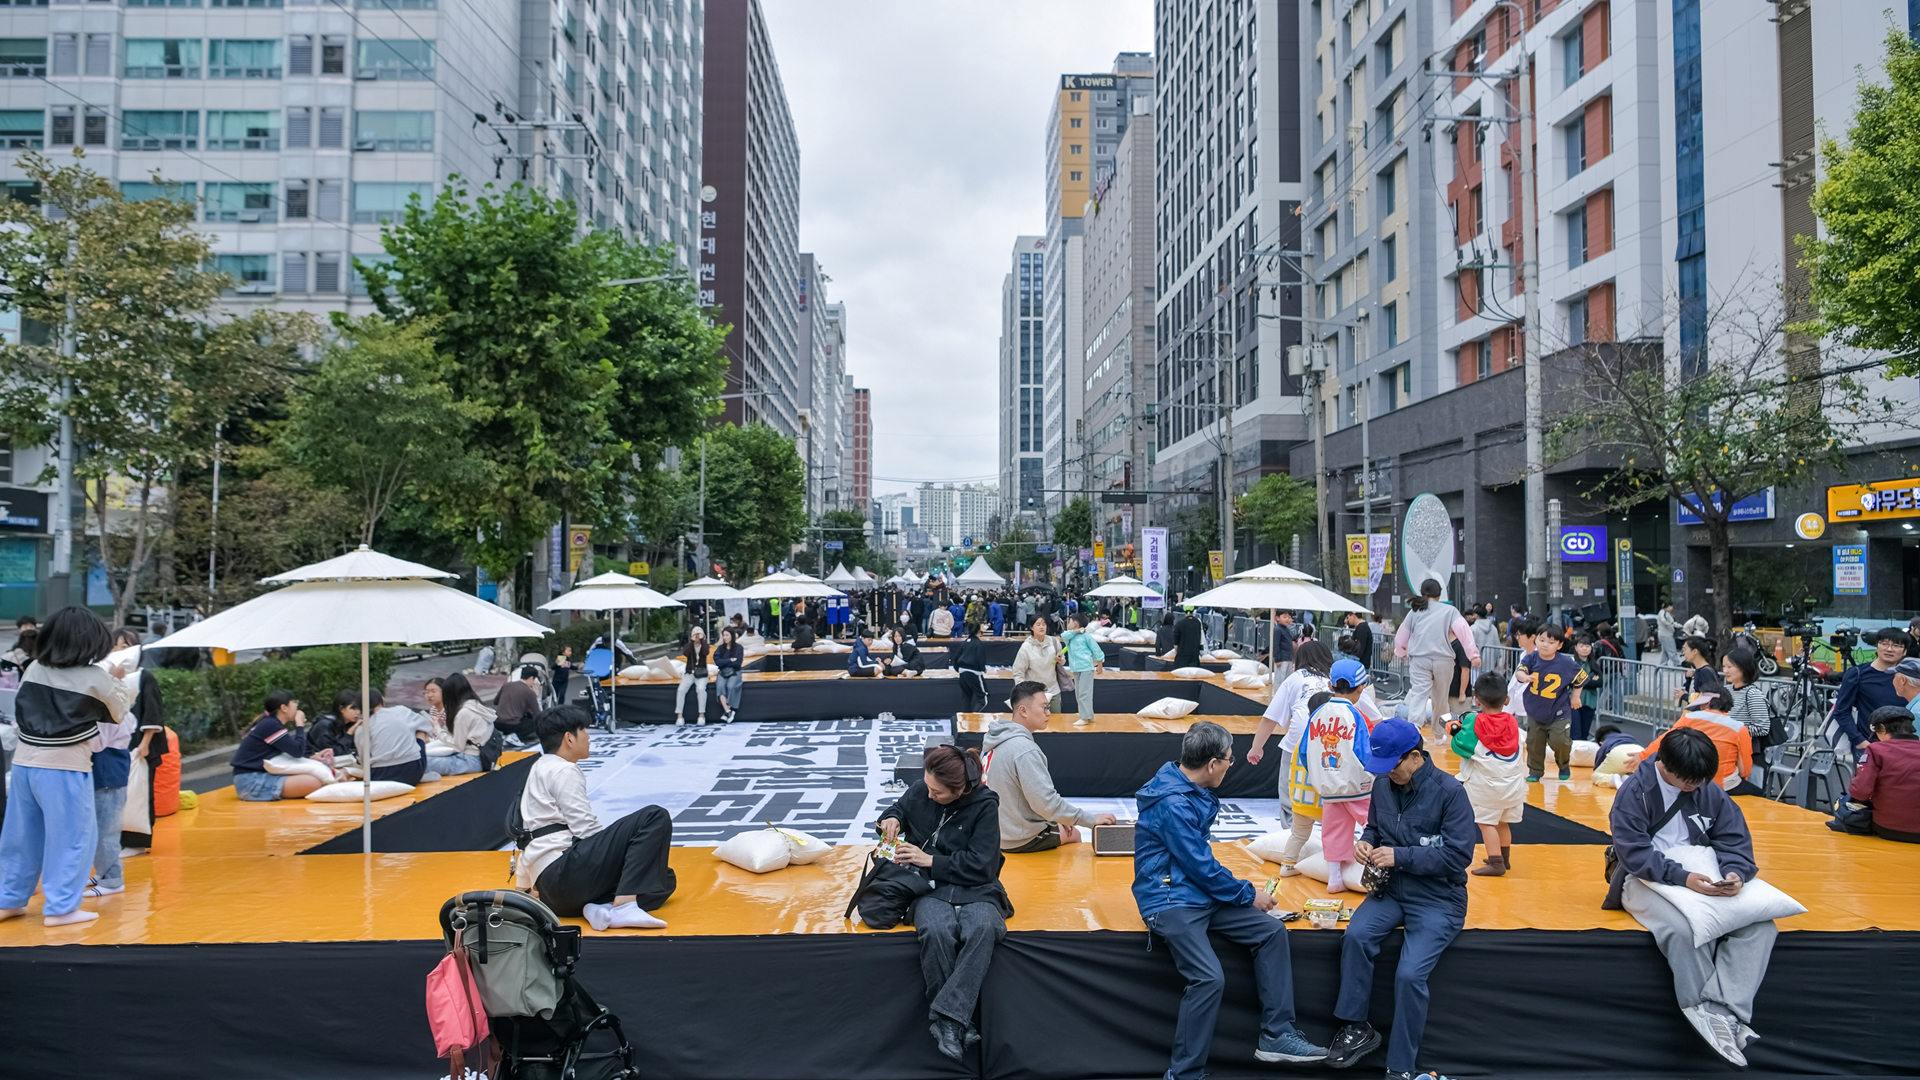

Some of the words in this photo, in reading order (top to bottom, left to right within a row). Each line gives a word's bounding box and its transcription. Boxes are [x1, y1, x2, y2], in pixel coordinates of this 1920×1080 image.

[1065, 76, 1076, 88] K
[1079, 77, 1114, 87] TOWER
[1150, 537, 1159, 570] 거리예술
[1567, 538, 1588, 550] CU
[1529, 671, 1562, 699] 12
[1310, 717, 1356, 741] Maikai
